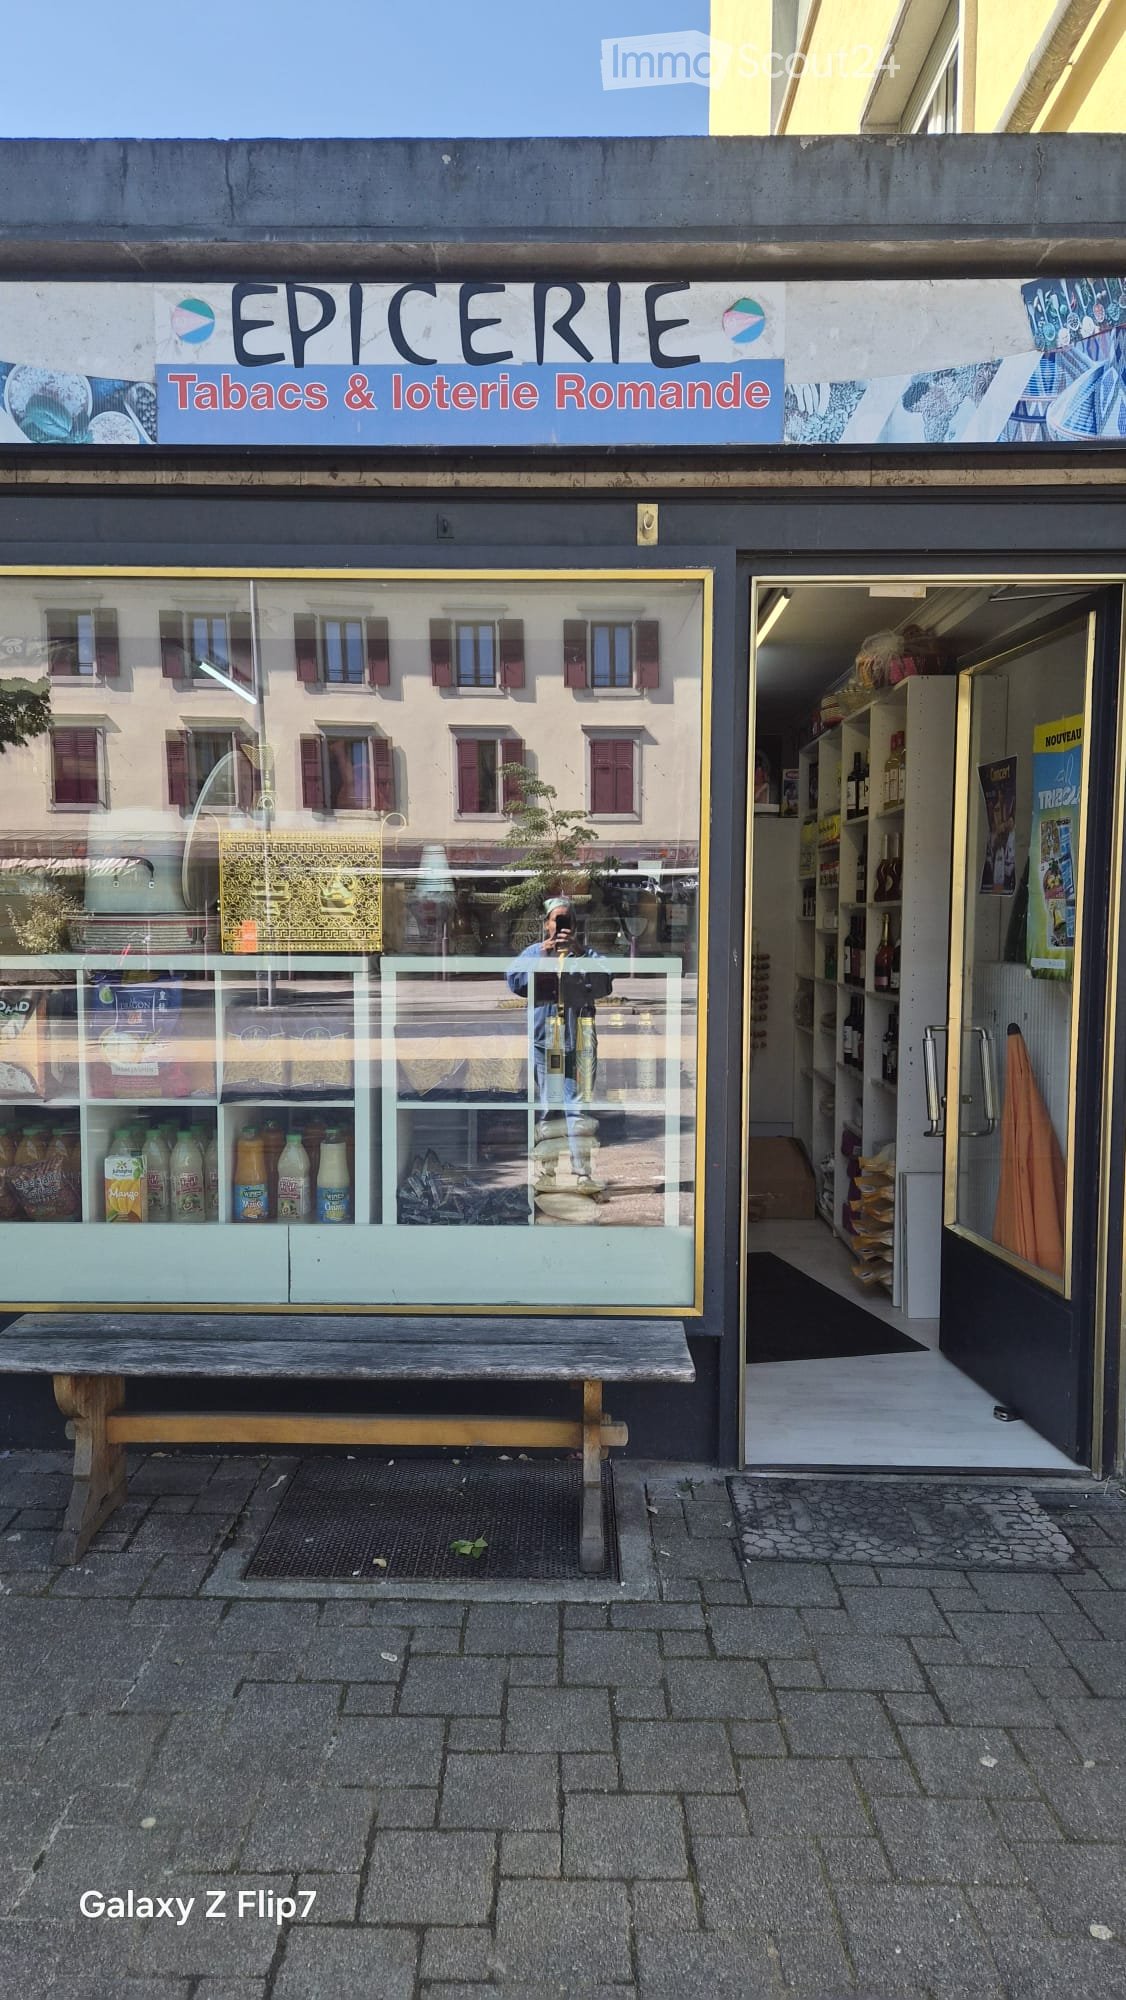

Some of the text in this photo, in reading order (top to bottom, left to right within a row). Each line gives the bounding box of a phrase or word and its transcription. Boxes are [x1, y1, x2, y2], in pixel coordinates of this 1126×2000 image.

[231, 282, 701, 369] EPICERIE
[168, 371, 772, 411] Tabacs & loterie Romande
[1045, 728, 1083, 748] NOUVEAU
[109, 1187, 139, 1200] Mango
